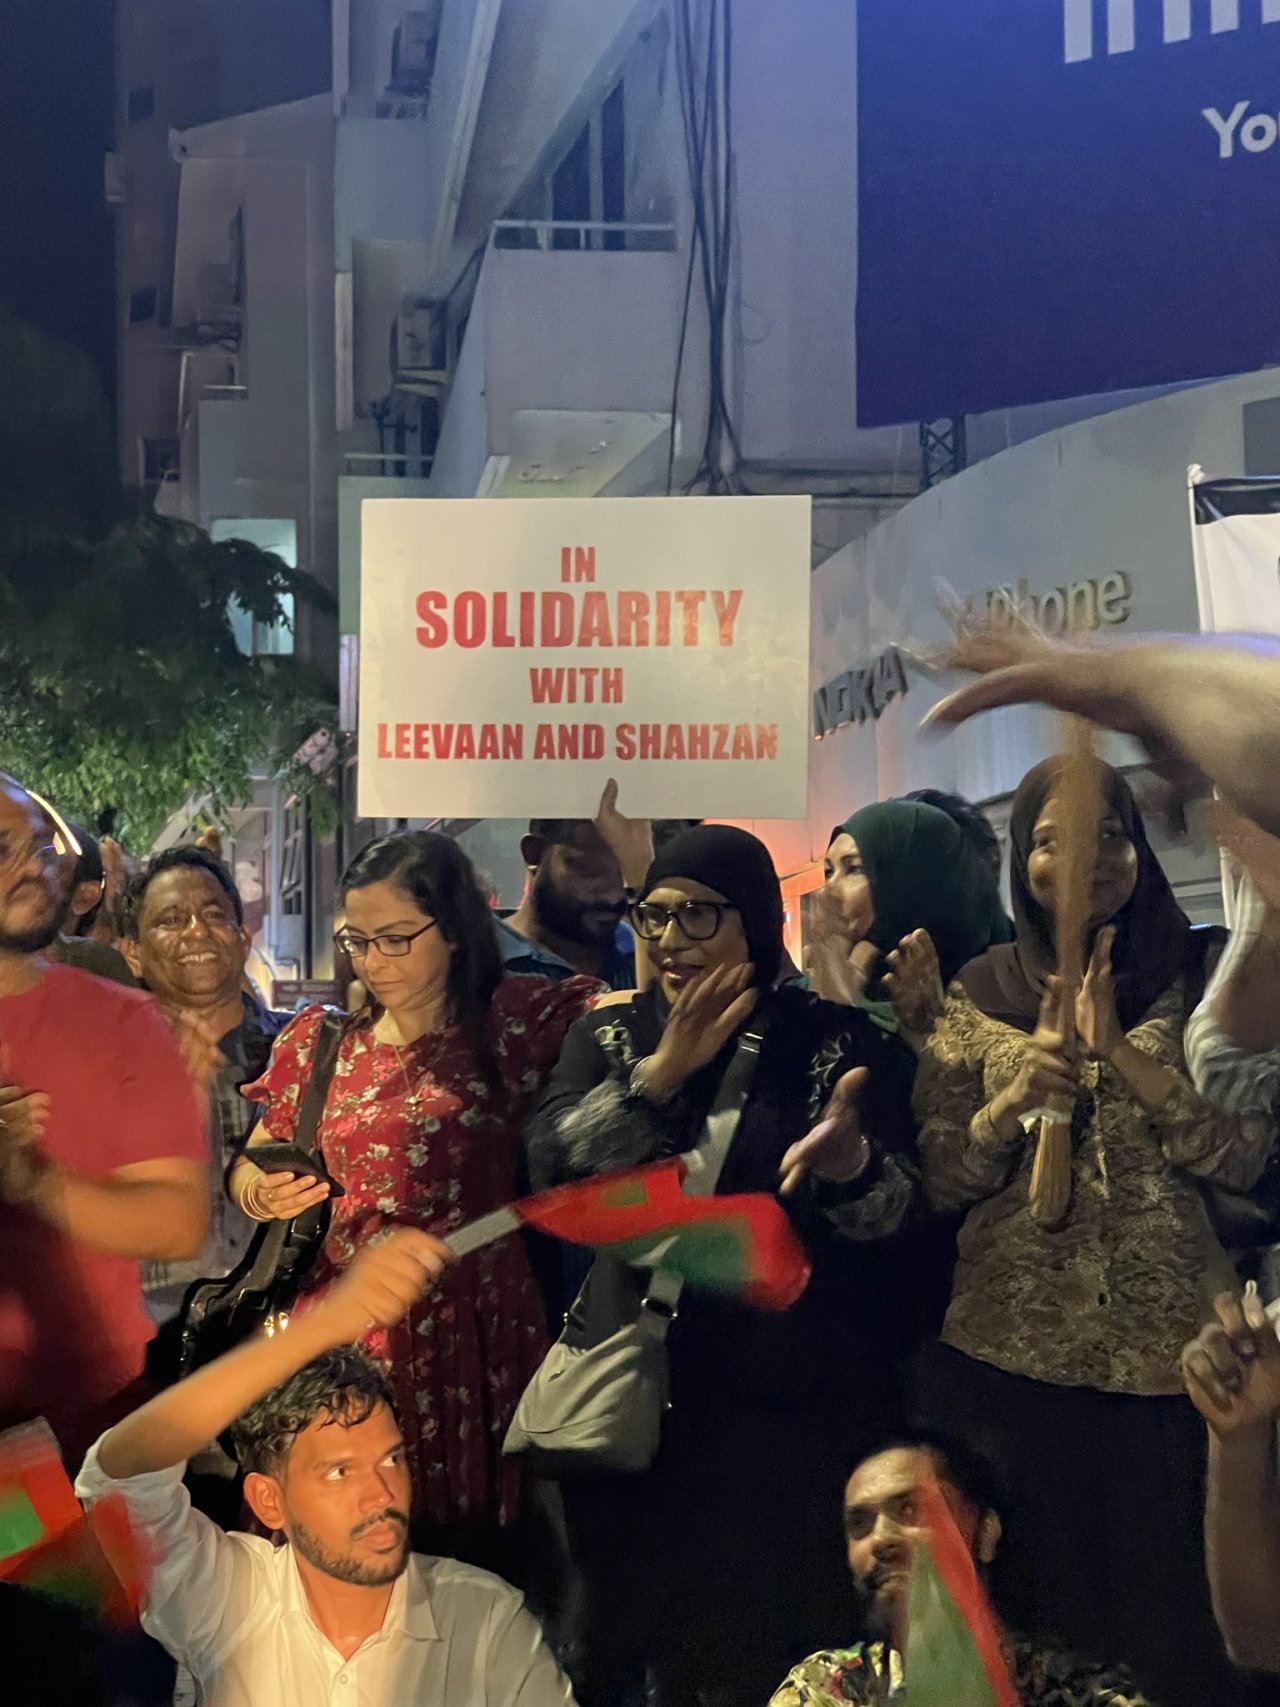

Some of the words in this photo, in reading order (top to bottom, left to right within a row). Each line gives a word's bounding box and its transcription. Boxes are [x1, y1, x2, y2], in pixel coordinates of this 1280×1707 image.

[1202, 100, 1280, 158] Yo
[561, 547, 596, 583] IN
[415, 590, 743, 649] SOLIDARITY
[529, 667, 624, 704] WITH
[377, 723, 523, 760] LEEVAAN
[533, 724, 604, 760] AND
[615, 723, 778, 761] SHAHZAN
